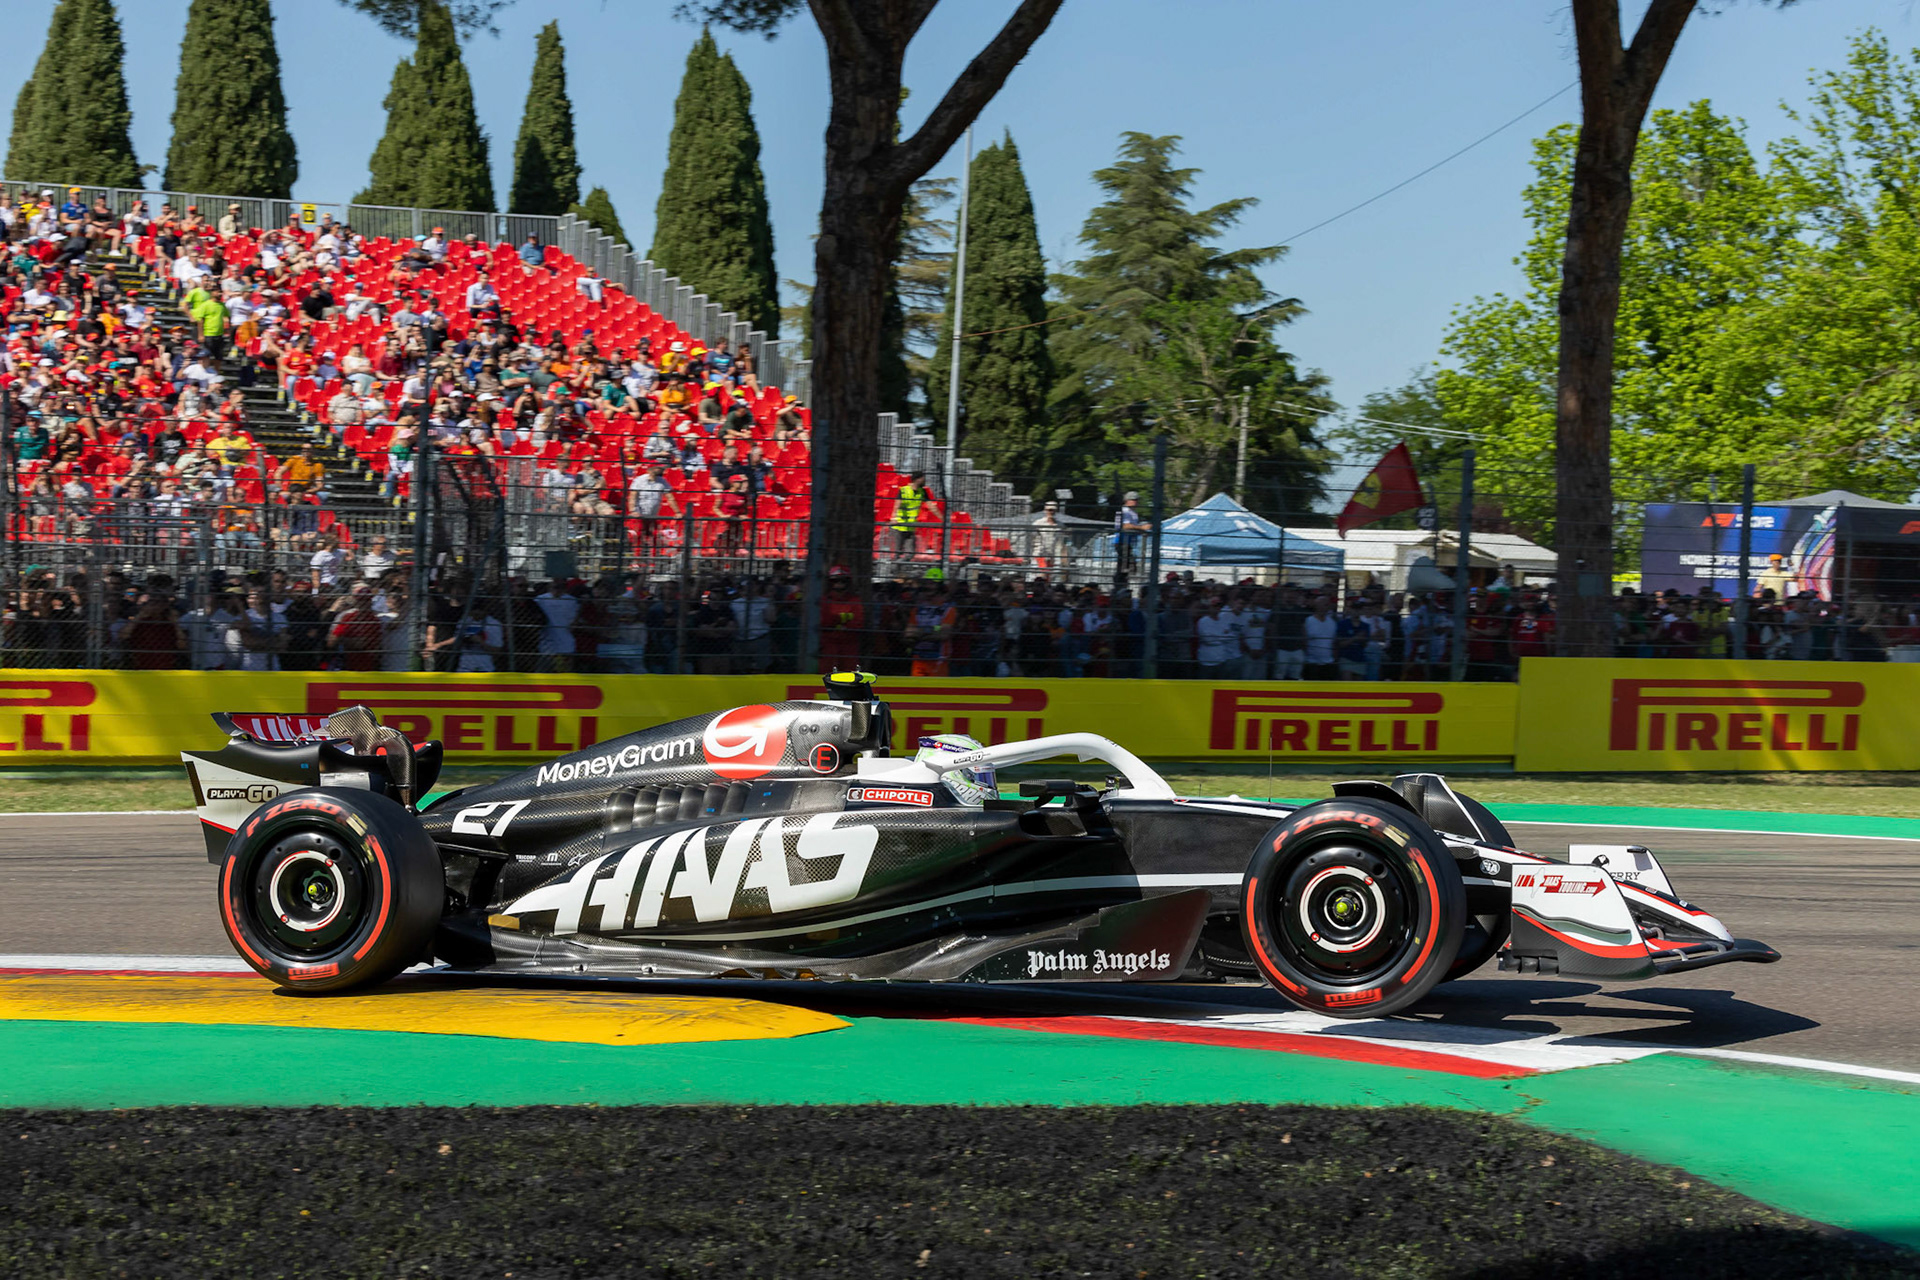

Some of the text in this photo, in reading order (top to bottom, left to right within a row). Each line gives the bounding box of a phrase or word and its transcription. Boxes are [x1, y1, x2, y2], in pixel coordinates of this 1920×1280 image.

[1209, 689, 1444, 751] PIRELLI
[1608, 678, 1866, 751] PIRELLI
[536, 738, 696, 787] MoneyGram
[248, 785, 278, 802] GO
[865, 789, 930, 804] CHIPOTLE
[451, 799, 532, 837] 27
[502, 810, 879, 936] HAAS
[1027, 948, 1171, 978] Palm Angels
